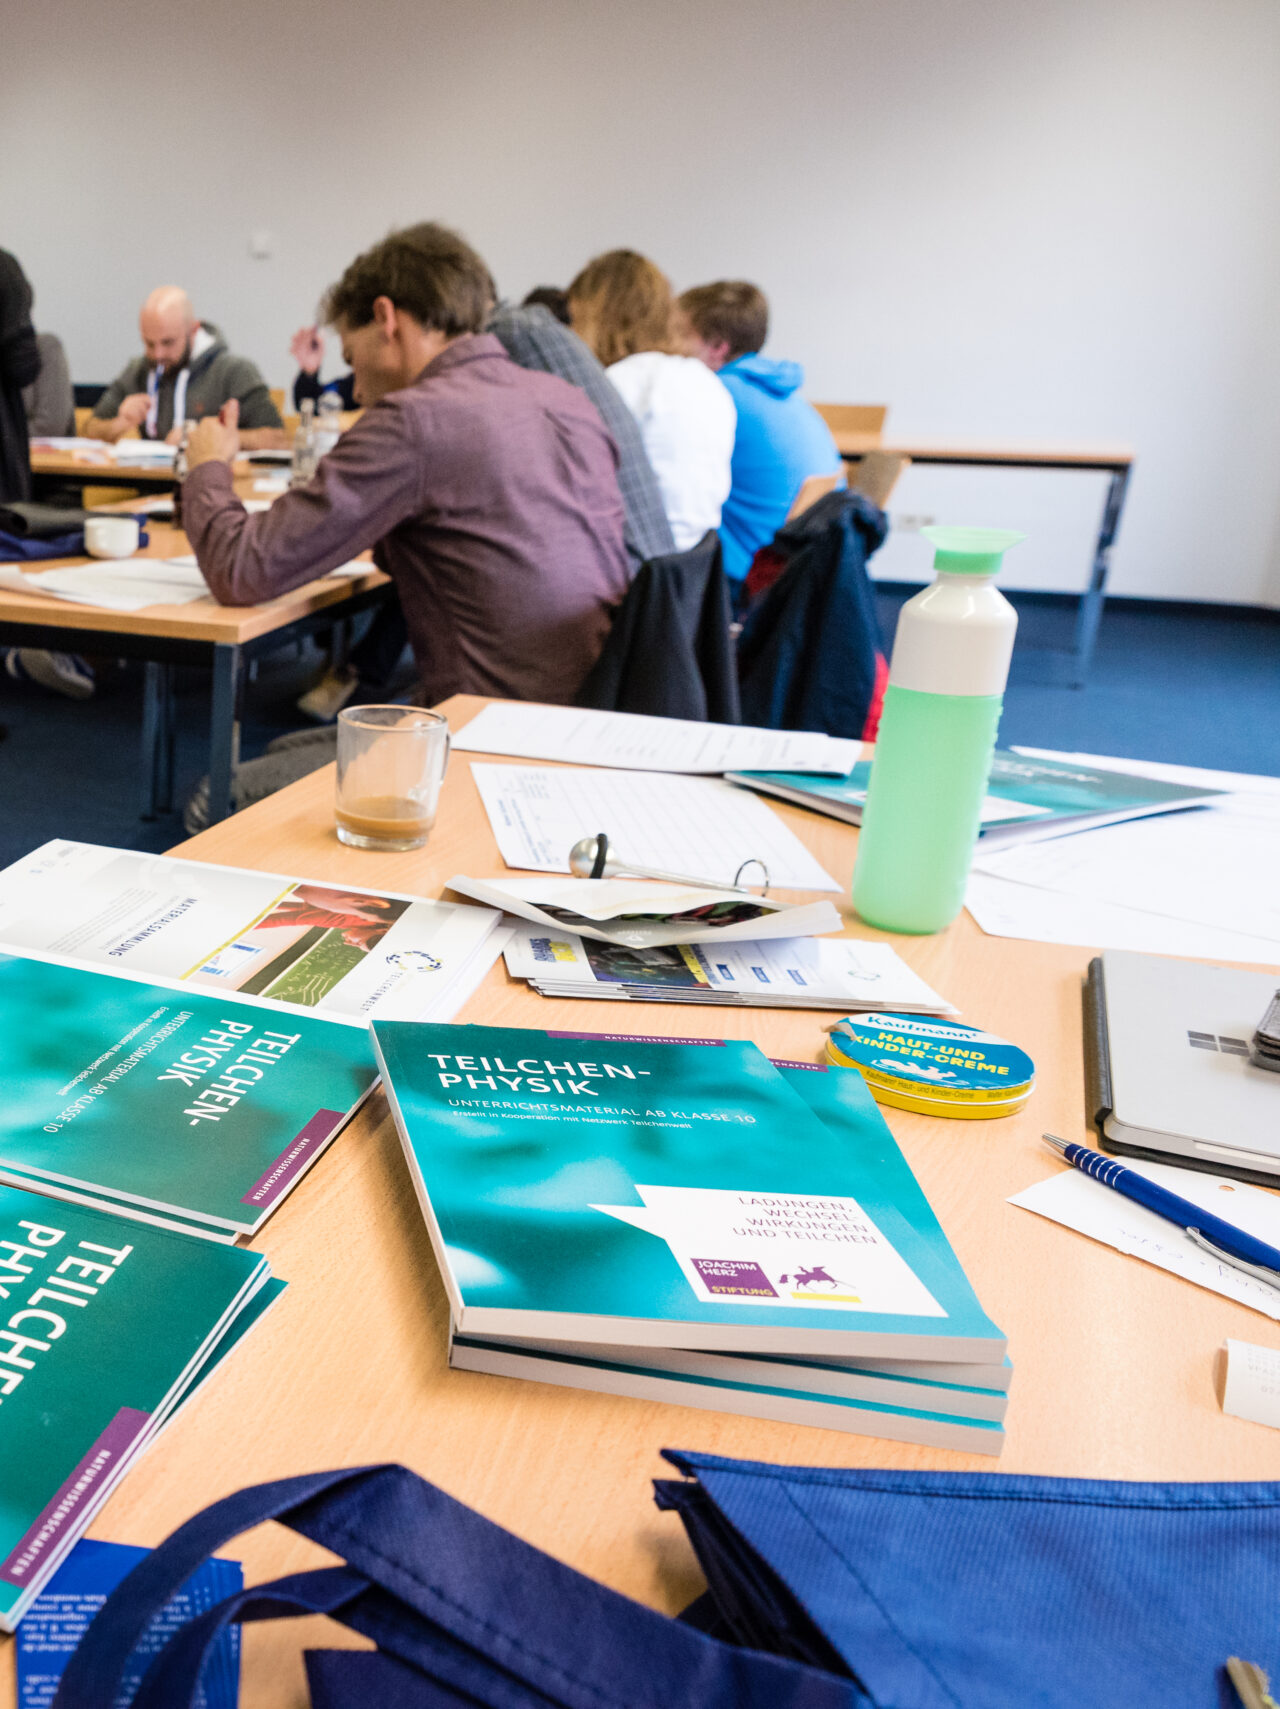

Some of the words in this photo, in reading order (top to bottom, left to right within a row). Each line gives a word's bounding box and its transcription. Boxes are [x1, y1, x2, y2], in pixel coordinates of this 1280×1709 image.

[100, 1010, 195, 1083] UNTERRICHTSMATERIAL
[604, 1035, 717, 1045] NATURWISSENSCHAFTEN
[156, 1019, 254, 1087] PHYSIK
[855, 1035, 1011, 1076] KINDER-CREME
[427, 1053, 651, 1079] TEILCHEN-
[183, 1031, 302, 1126] TEILCHEN-
[438, 1073, 599, 1096] PHYSIK
[88, 1083, 109, 1095] AB
[56, 1094, 97, 1122] KLASSE
[448, 1098, 640, 1116] UNTERRICHTSMATERIAL
[645, 1109, 666, 1118] AB
[671, 1111, 730, 1122] KLASSE
[735, 1114, 757, 1124] 10
[43, 1122, 64, 1133] 10
[452, 1110, 486, 1118] Erstellt
[501, 1112, 560, 1121] Kooperation
[581, 1116, 628, 1126] Netzwerk
[630, 1119, 693, 1129] Teilchenwelt
[252, 1137, 311, 1201] NATURWISSENSCHAFTEN
[738, 1196, 853, 1213] LADUNGEN,
[762, 1208, 857, 1222] WECHSEL-
[732, 1227, 777, 1238] UND
[745, 1217, 869, 1233] WIRKUNGEN
[781, 1230, 877, 1244] TEILCHEN
[697, 1260, 757, 1271] JOACHIM
[702, 1267, 738, 1277] HERZ
[711, 1286, 774, 1296] STIFTUNG
[9, 1449, 112, 1577] NATURWISSENSCHAFTEN
